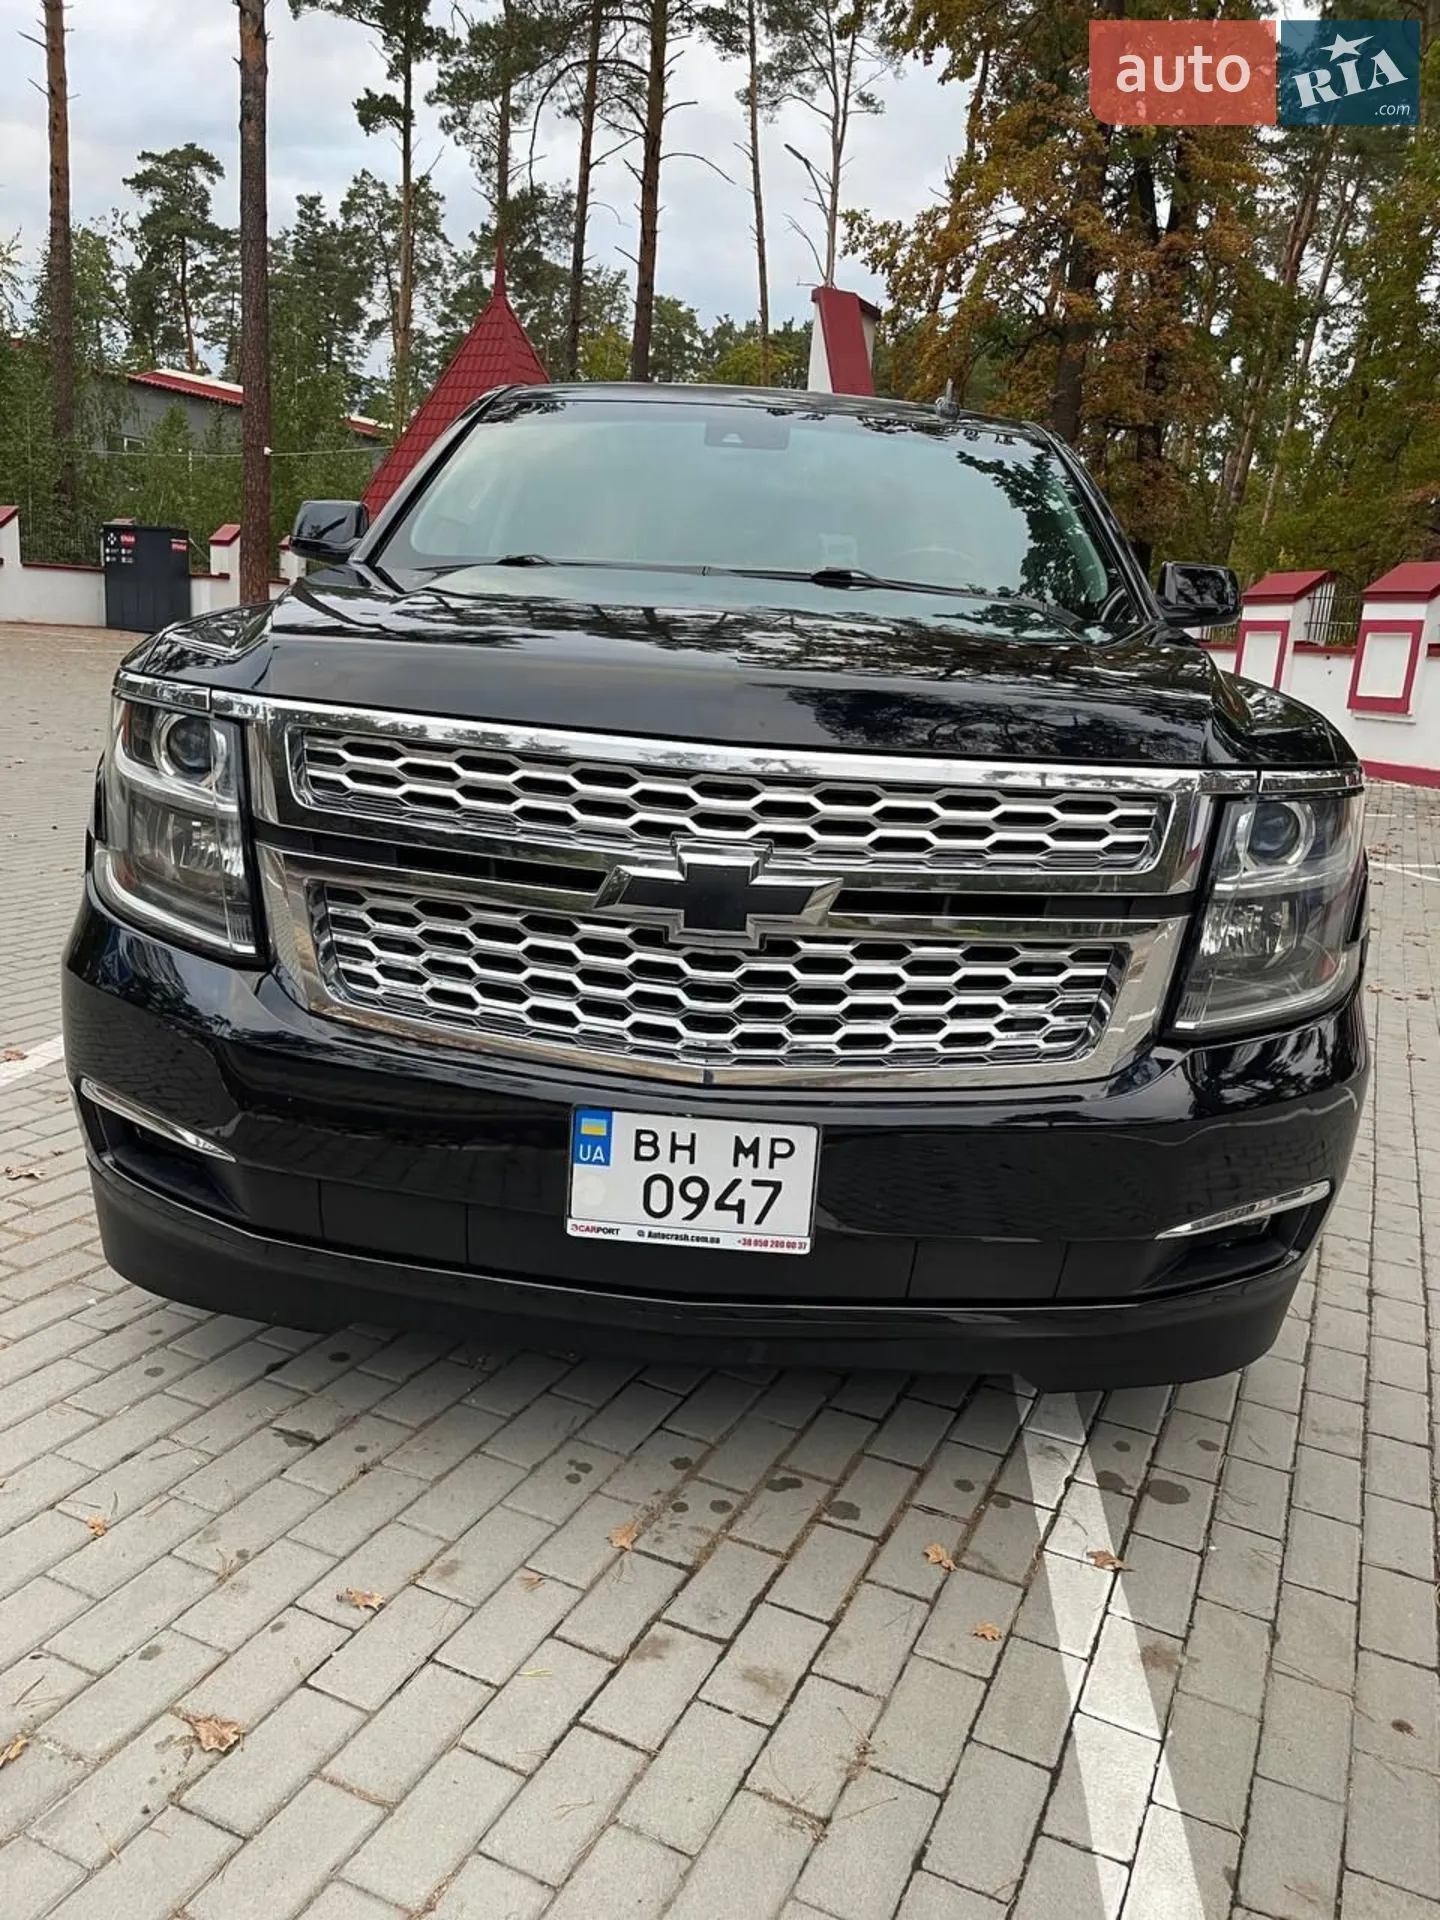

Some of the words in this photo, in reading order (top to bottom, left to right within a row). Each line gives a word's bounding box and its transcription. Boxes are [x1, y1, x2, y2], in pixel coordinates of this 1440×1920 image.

[579, 1144, 606, 1163] UA
[634, 1129, 696, 1165] BH
[733, 1135, 796, 1170] MP
[642, 1173, 783, 1225] 0947
